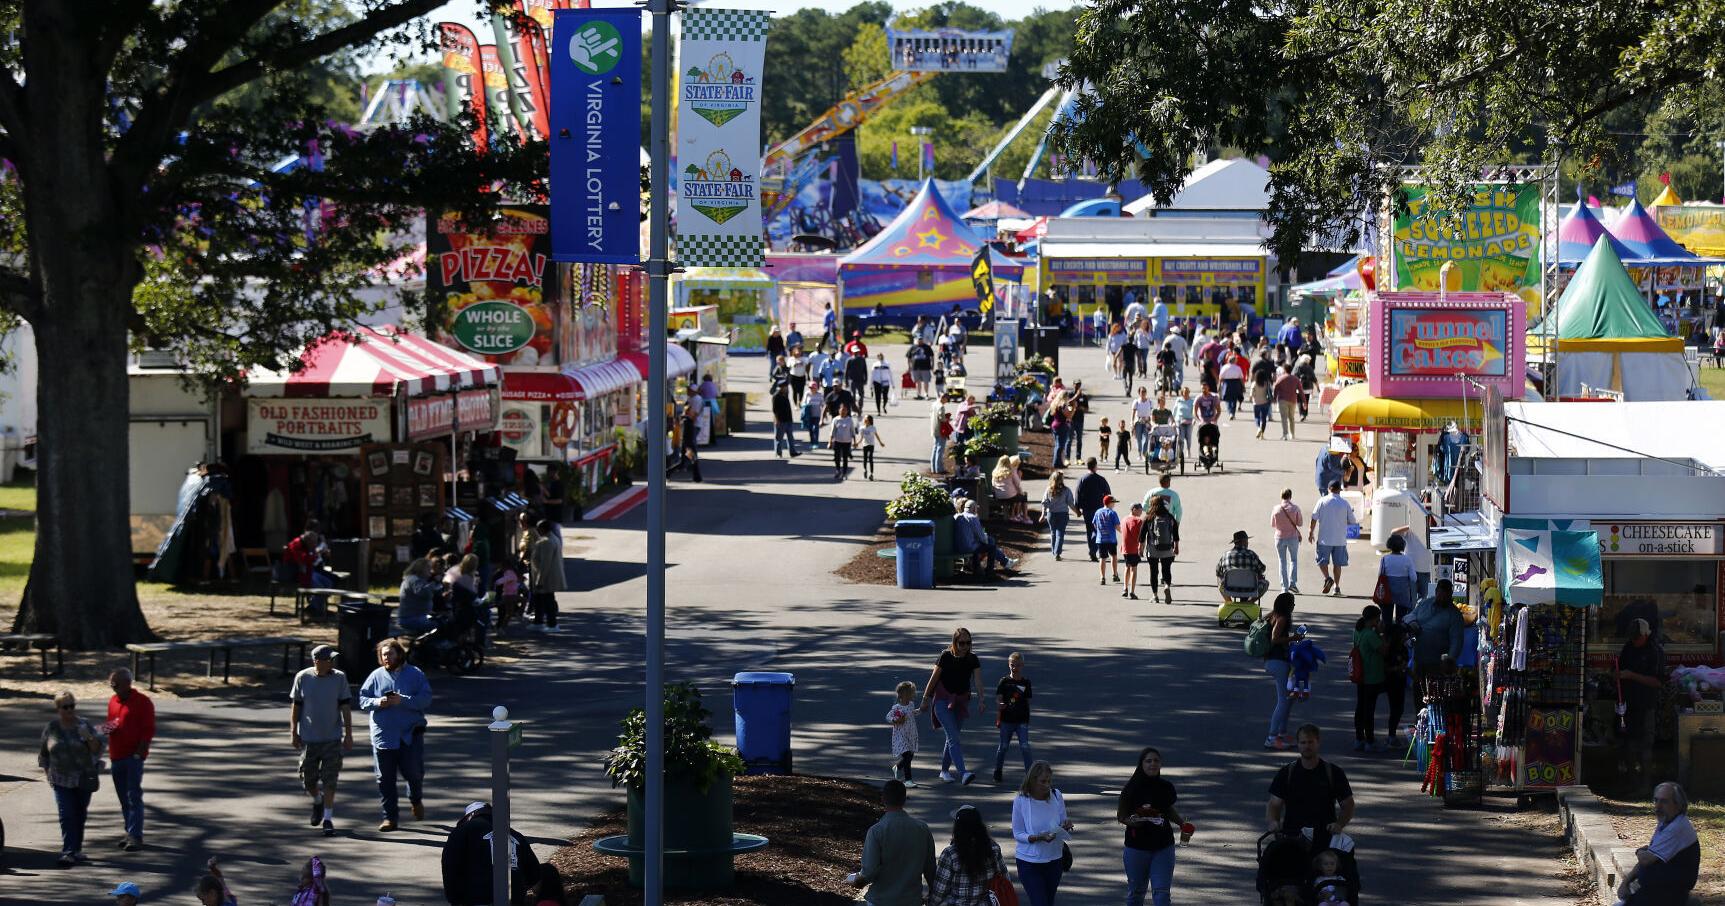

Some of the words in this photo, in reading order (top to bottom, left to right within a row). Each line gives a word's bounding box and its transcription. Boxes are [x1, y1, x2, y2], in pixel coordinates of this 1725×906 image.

[686, 85, 722, 100] STATE
[725, 86, 753, 100] FAIR
[587, 80, 602, 162] VIRGINIA
[685, 183, 721, 196] STATE
[724, 183, 753, 197] FAIR
[587, 169, 602, 252] LOTTERY
[1407, 191, 1516, 215] FSH
[1404, 234, 1530, 259] LEMONADE
[441, 246, 546, 286] PIZZA!
[466, 311, 520, 323] WHOLE
[1395, 315, 1501, 340] Funnel
[474, 335, 513, 347] SLICE
[1000, 335, 1014, 377] ATM
[1392, 343, 1485, 369] Cakes
[260, 406, 288, 419] OLD
[292, 406, 378, 420] FASHIONED
[277, 421, 362, 435] PORTRAITS
[1622, 525, 1712, 539] CHEESECAKE
[1639, 540, 1695, 553] on-a-stick
[1528, 766, 1572, 781] BOX
